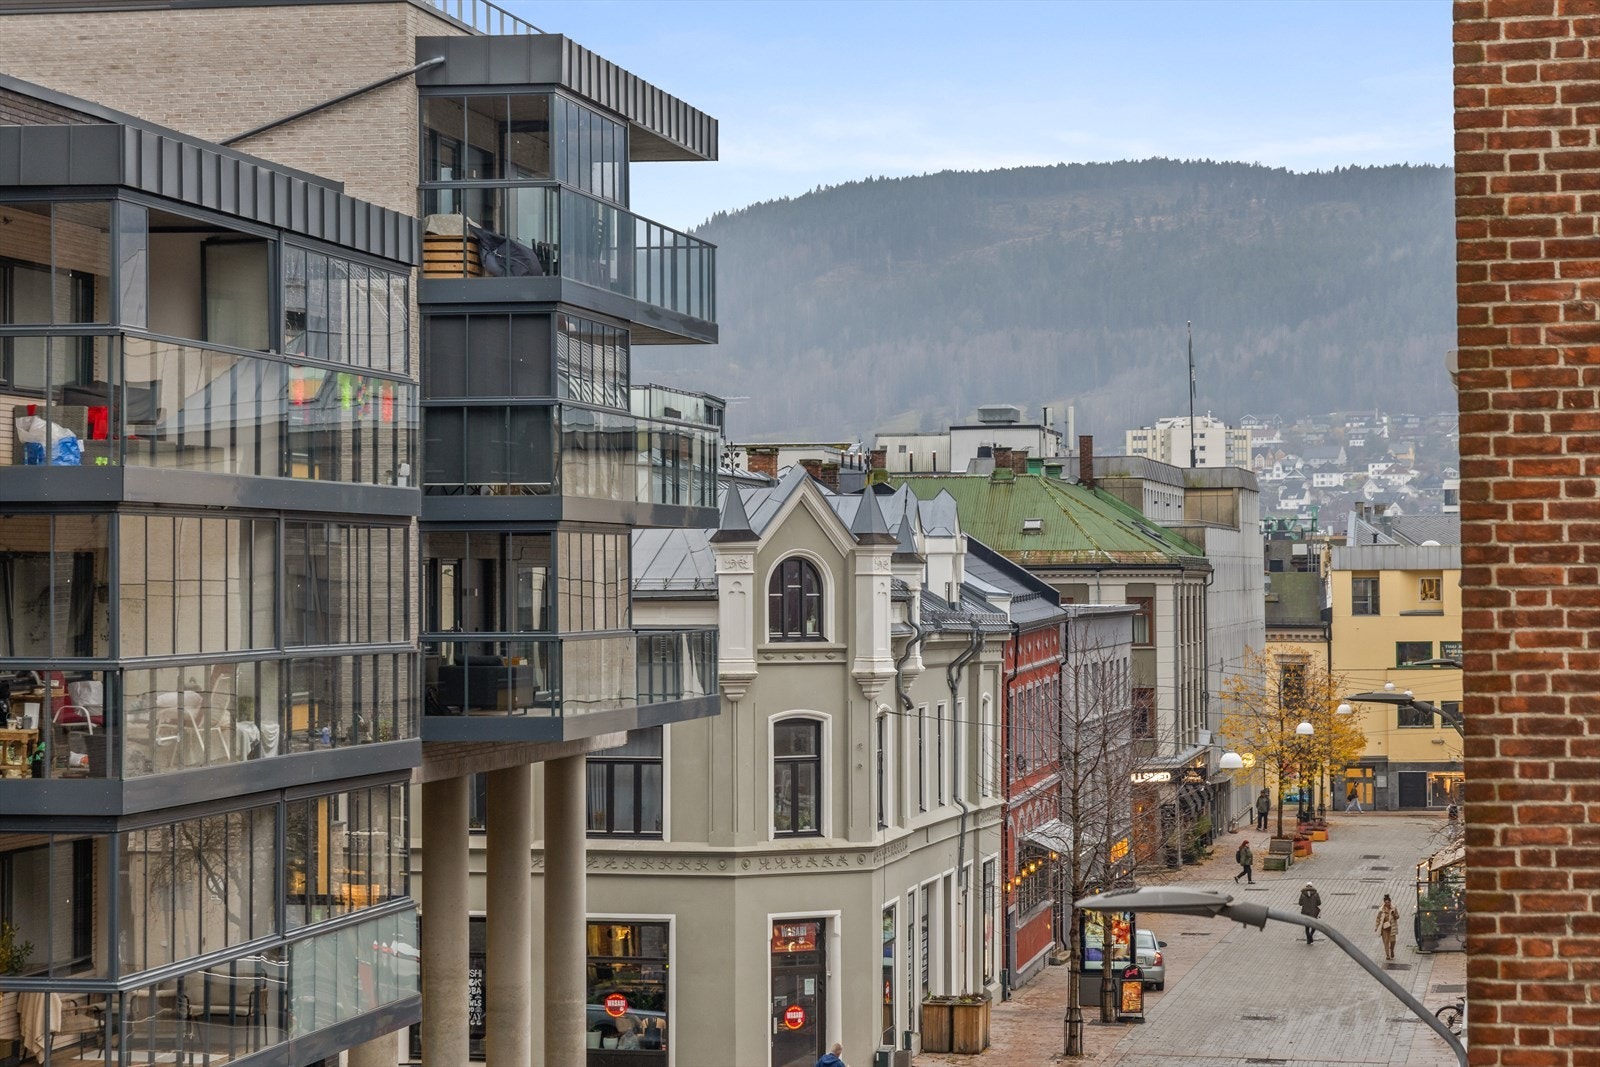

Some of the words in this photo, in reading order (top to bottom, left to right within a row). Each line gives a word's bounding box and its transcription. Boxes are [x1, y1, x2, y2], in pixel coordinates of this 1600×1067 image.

[781, 926, 807, 937] WASABI
[607, 999, 626, 1007] WASABI
[786, 1011, 804, 1019] WASABI
